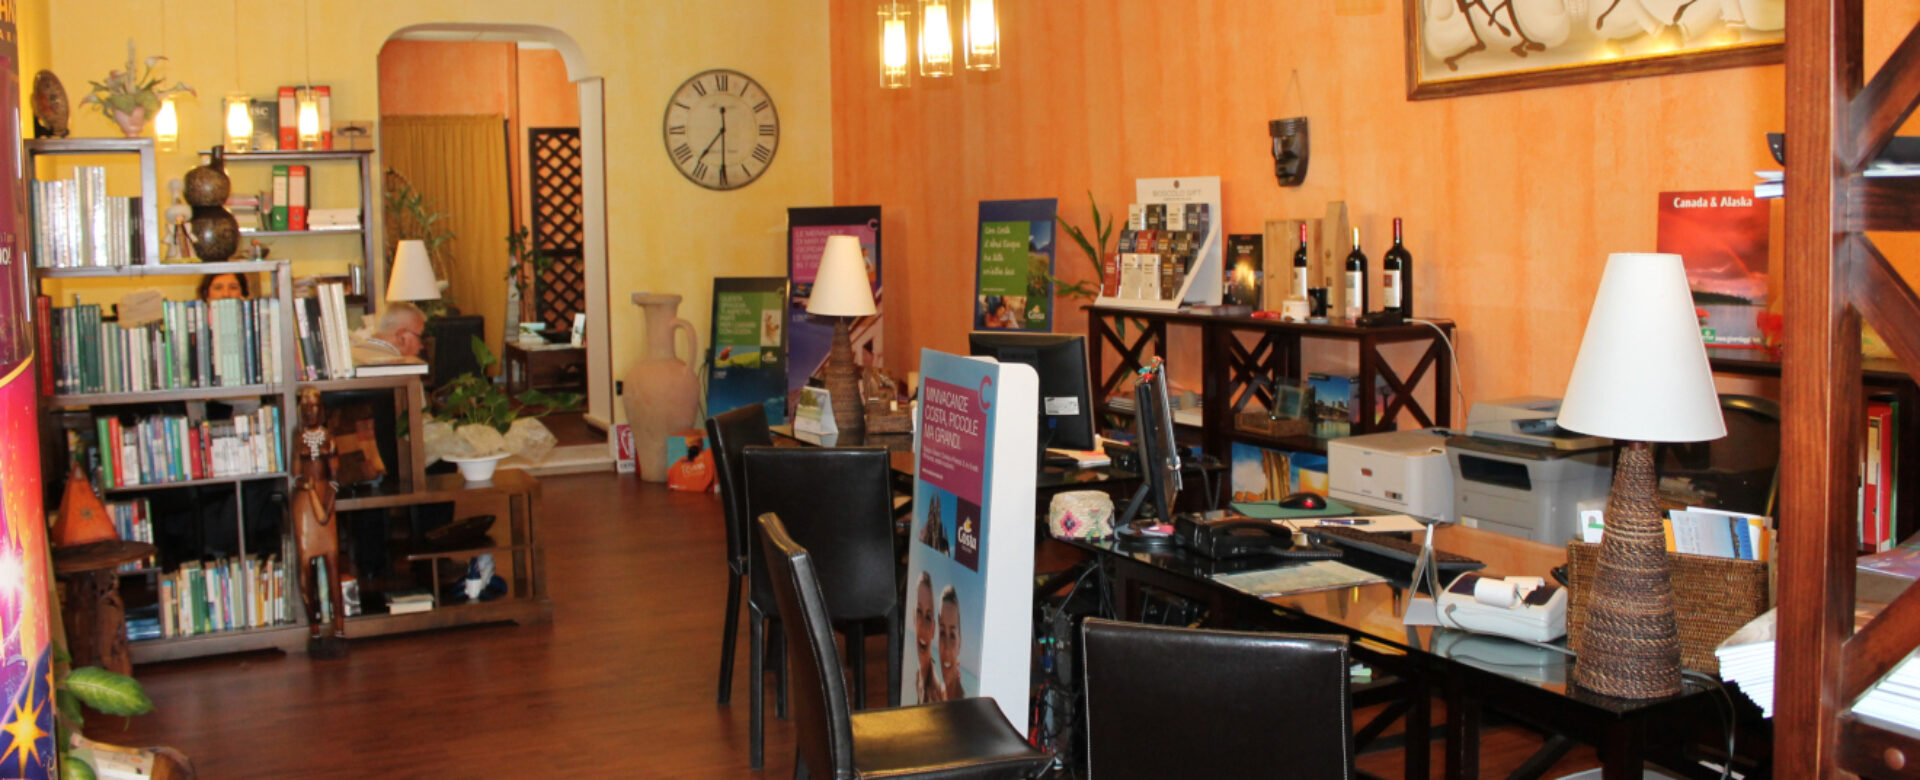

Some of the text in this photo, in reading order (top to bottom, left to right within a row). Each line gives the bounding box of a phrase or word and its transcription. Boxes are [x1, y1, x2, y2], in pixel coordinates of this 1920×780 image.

[251, 107, 269, 117] SC
[1672, 196, 1753, 209] Canada & Alaska
[924, 423, 935, 441] MA
[949, 412, 979, 437] PICCOLE
[958, 526, 977, 551] Costa
